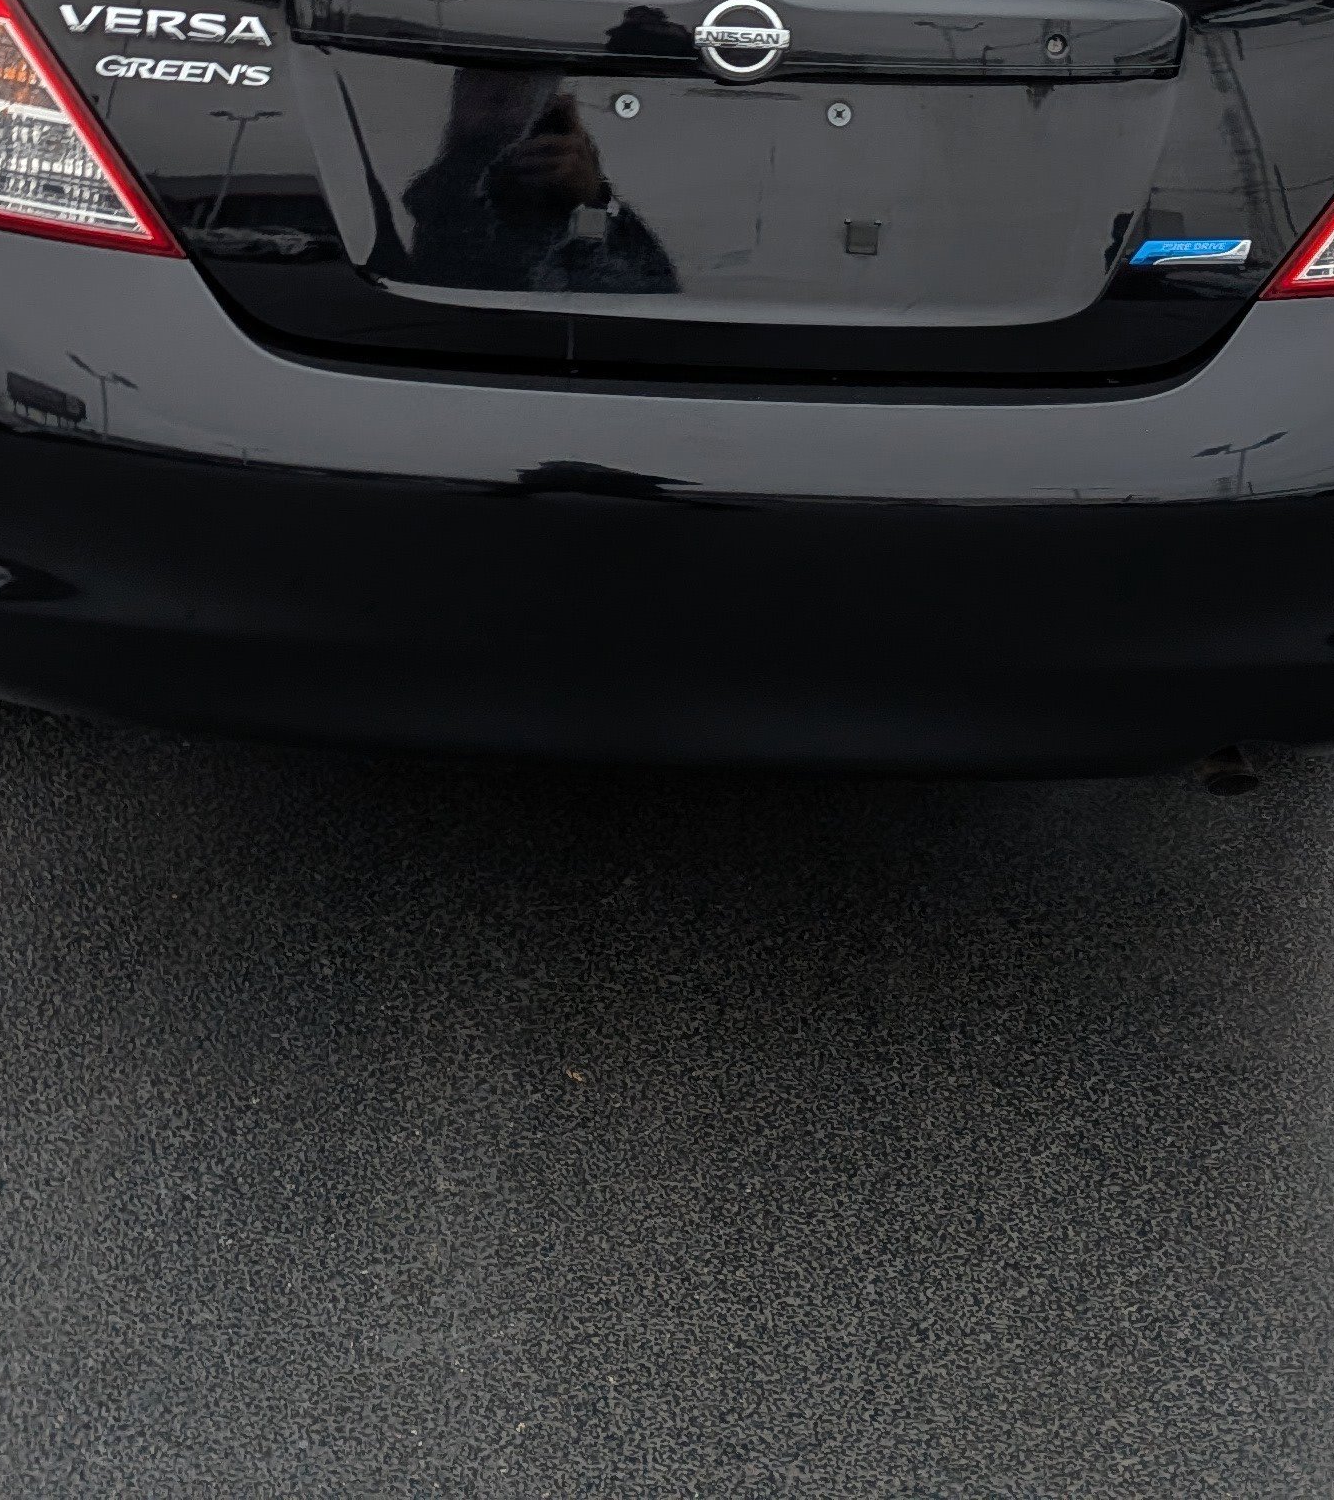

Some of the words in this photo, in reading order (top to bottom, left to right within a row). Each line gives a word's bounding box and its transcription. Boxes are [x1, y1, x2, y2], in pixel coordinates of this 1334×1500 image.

[59, 4, 272, 46] VERSA
[706, 30, 781, 45] NISSAN
[1194, 242, 1227, 251] DRIVE
